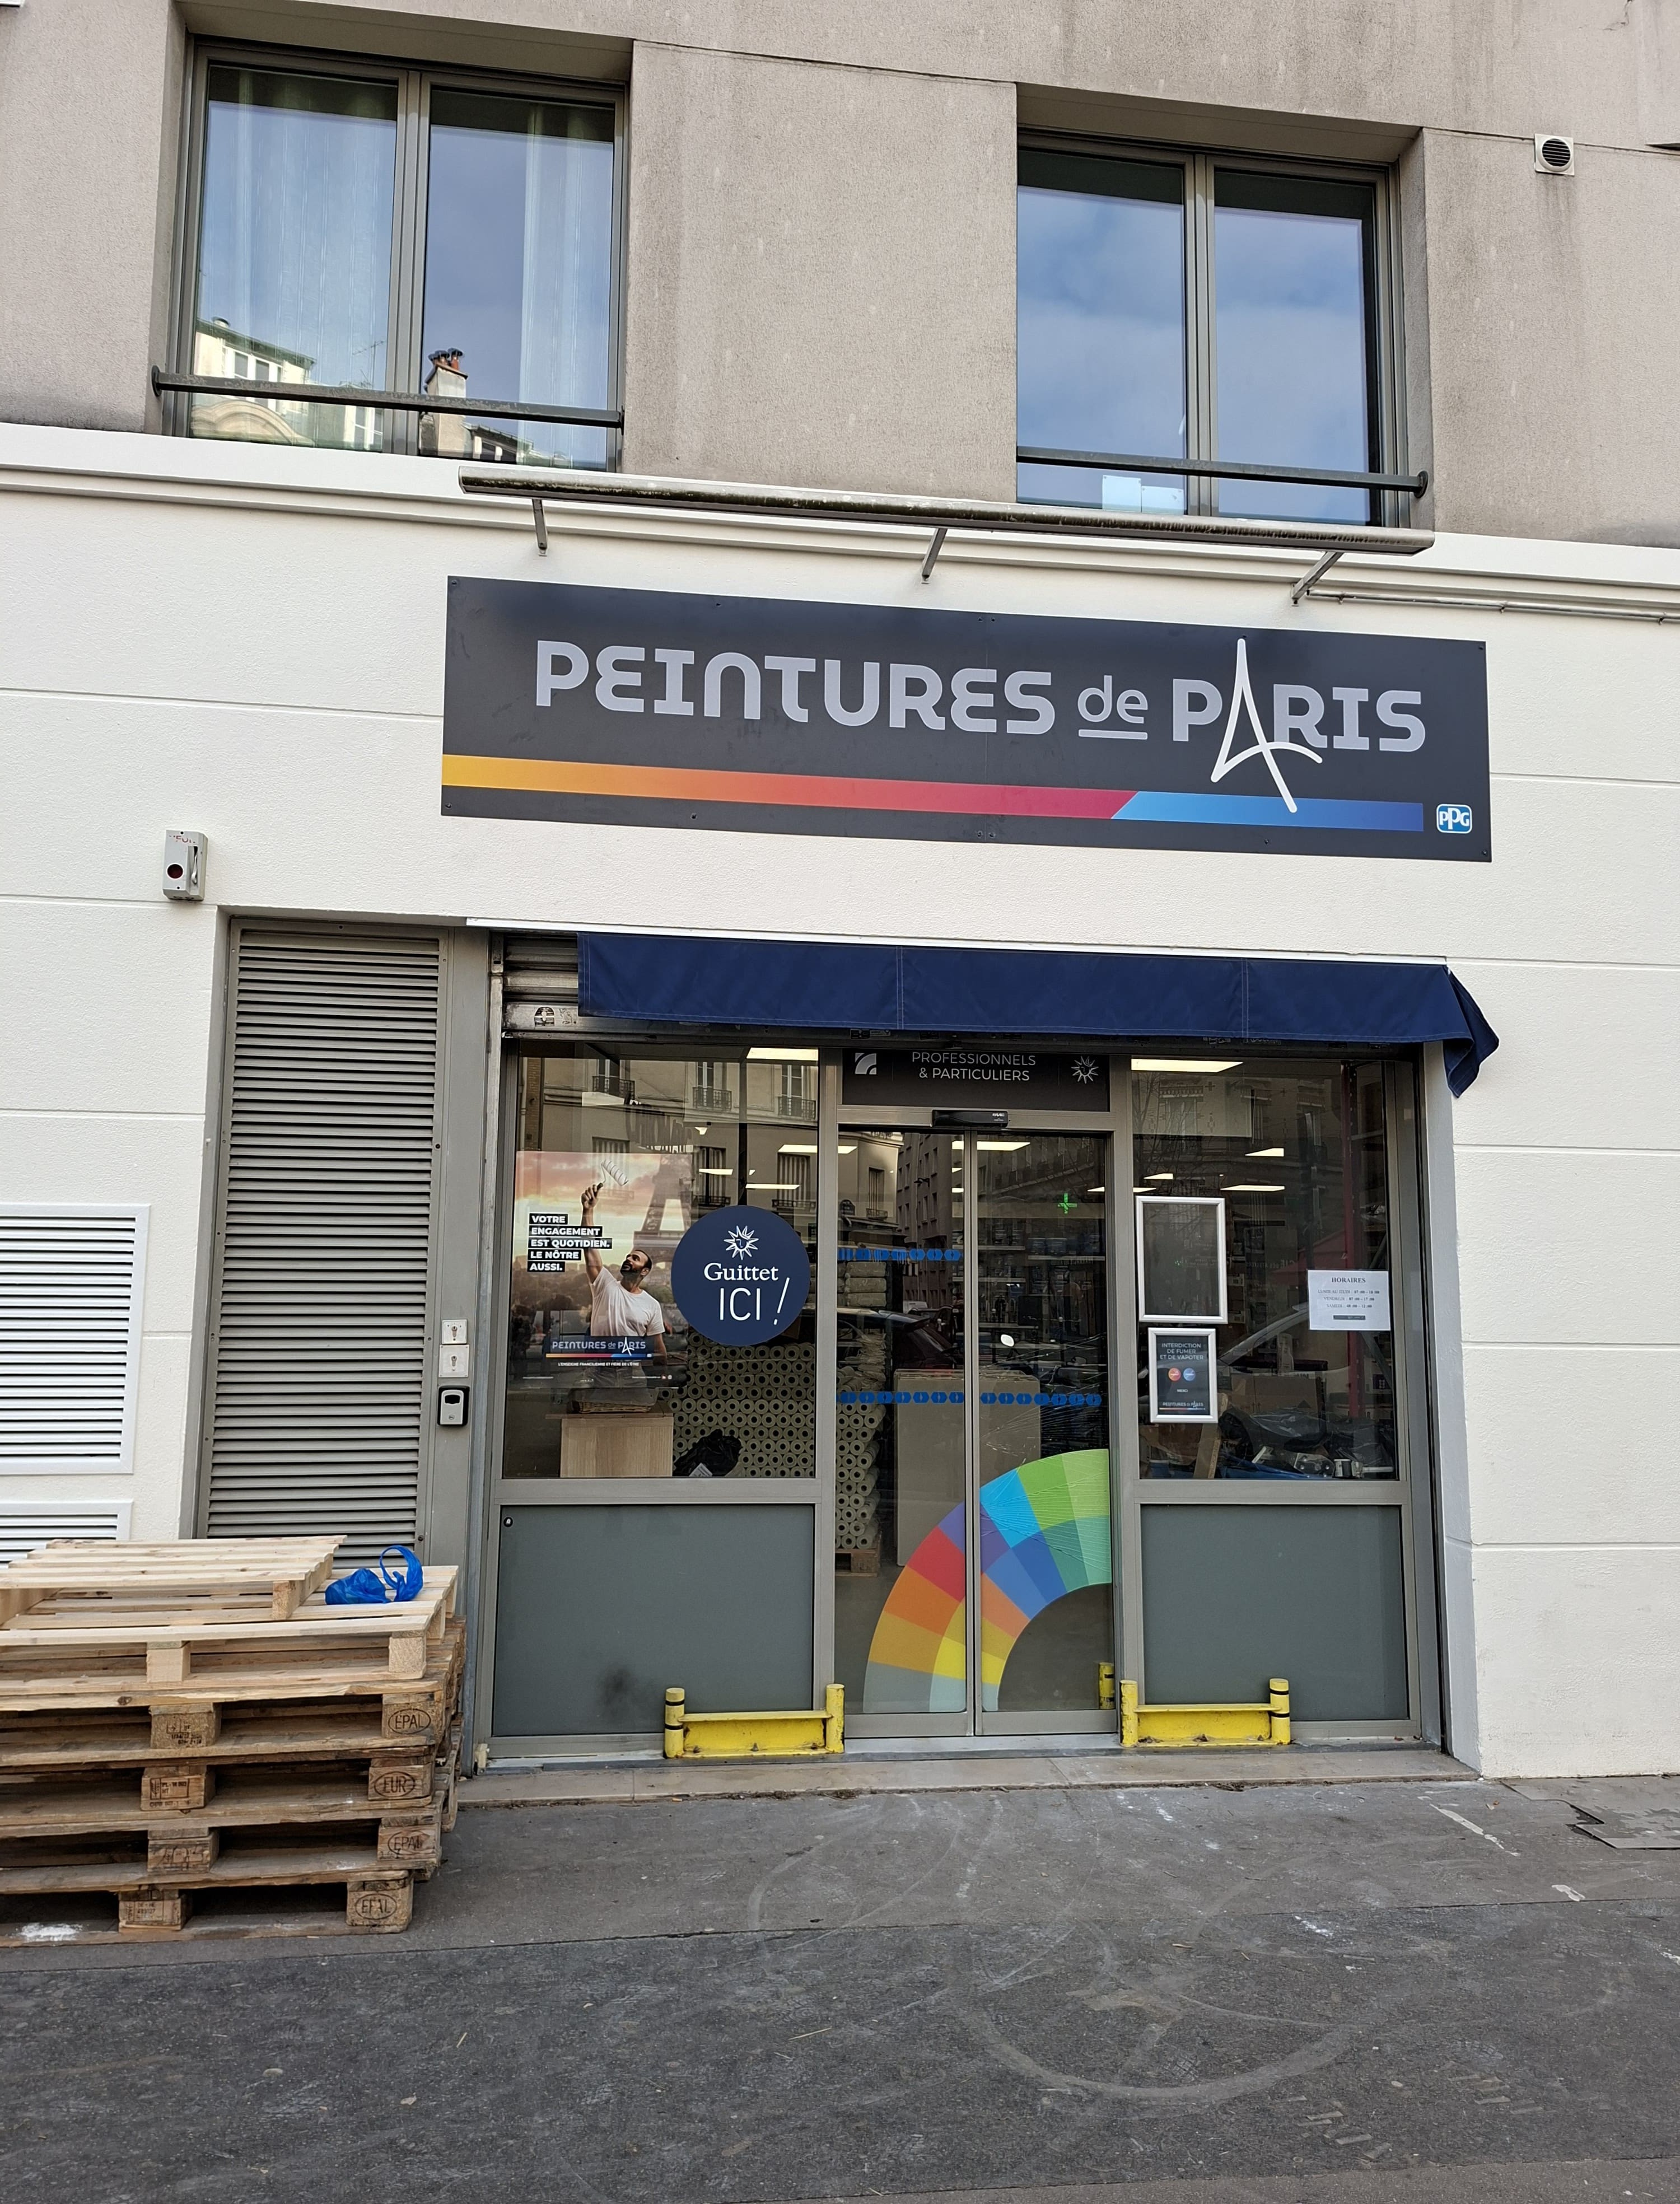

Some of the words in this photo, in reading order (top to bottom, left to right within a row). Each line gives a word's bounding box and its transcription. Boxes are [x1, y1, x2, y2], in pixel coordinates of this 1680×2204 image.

[536, 640, 1054, 734] PEINTURES
[1077, 675, 1148, 723] de
[1173, 638, 1425, 813] PARIS
[1439, 807, 1470, 829] PPG
[912, 1052, 1035, 1066] PROFESSIONNELS
[919, 1067, 928, 1078] &
[933, 1068, 1029, 1081] PARTICULIERS
[552, 1240, 610, 1248] QUOTIDIEN.
[545, 1250, 579, 1259] NÔTRE
[704, 1262, 778, 1281] Guittet
[720, 1287, 760, 1320] ICI
[618, 1337, 646, 1356] PARIS
[395, 1715, 424, 1729] EPAL
[383, 1776, 406, 1793] EUR
